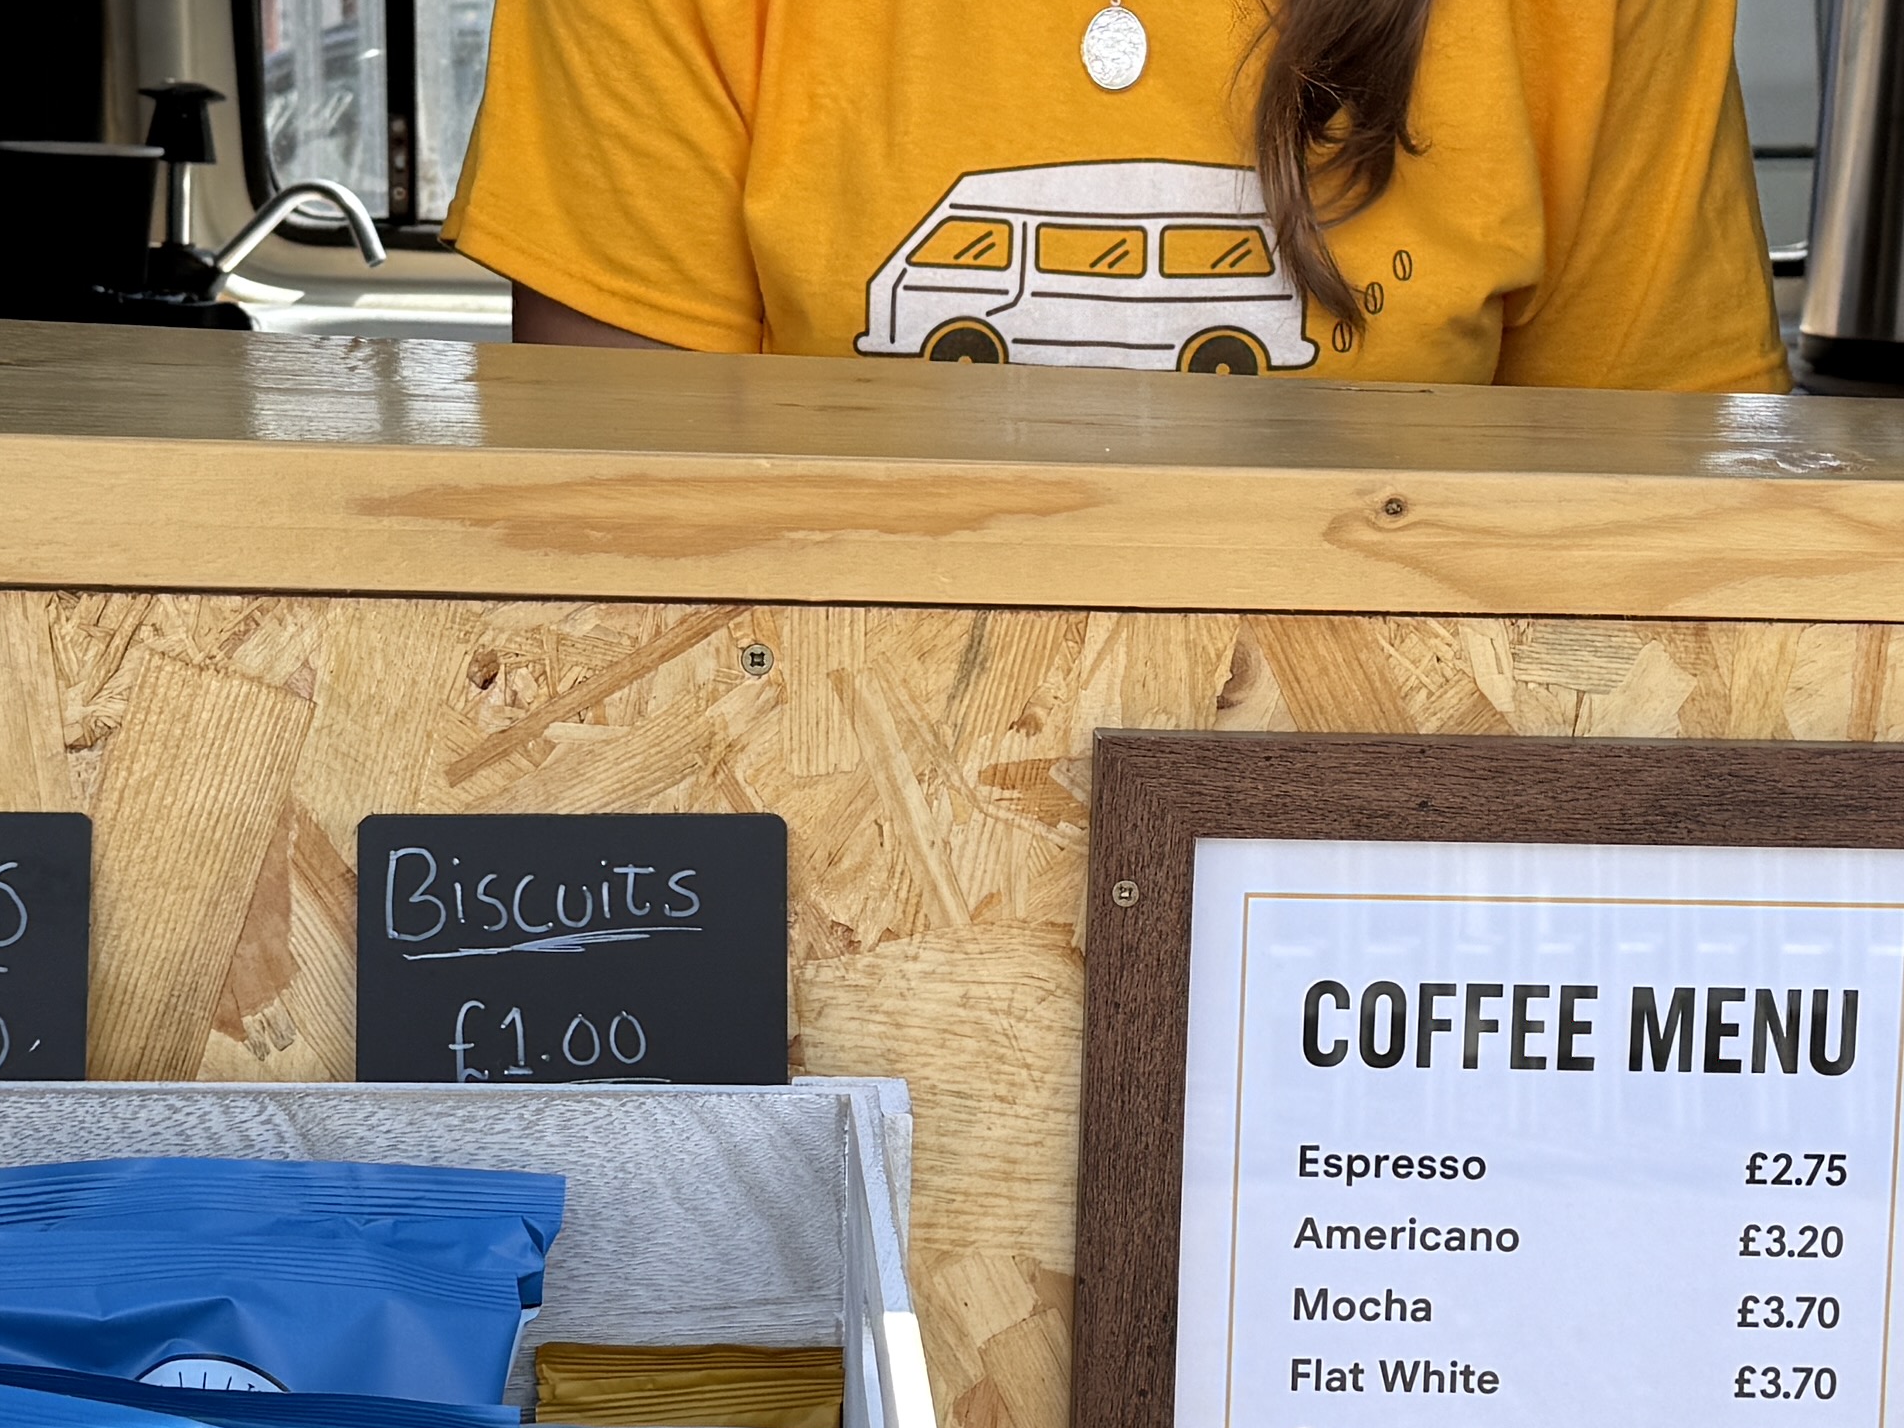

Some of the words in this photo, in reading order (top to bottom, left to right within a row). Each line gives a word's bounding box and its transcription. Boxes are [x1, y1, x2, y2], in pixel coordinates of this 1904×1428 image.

[386, 847, 703, 947] Biscuits
[448, 998, 648, 1083] £1.00
[1301, 979, 1600, 1071] COFFEE
[1628, 984, 1860, 1078] MENU
[1298, 1144, 1487, 1187] Espresso
[1745, 1152, 1848, 1189] £2.75
[1293, 1216, 1521, 1255] Americano
[1739, 1224, 1844, 1260] £3.20
[1292, 1288, 1433, 1325] Mocha
[1736, 1295, 1841, 1331] £3.70
[1289, 1358, 1364, 1394] Flat
[1380, 1359, 1500, 1397] White
[1733, 1366, 1837, 1402] £3.70
